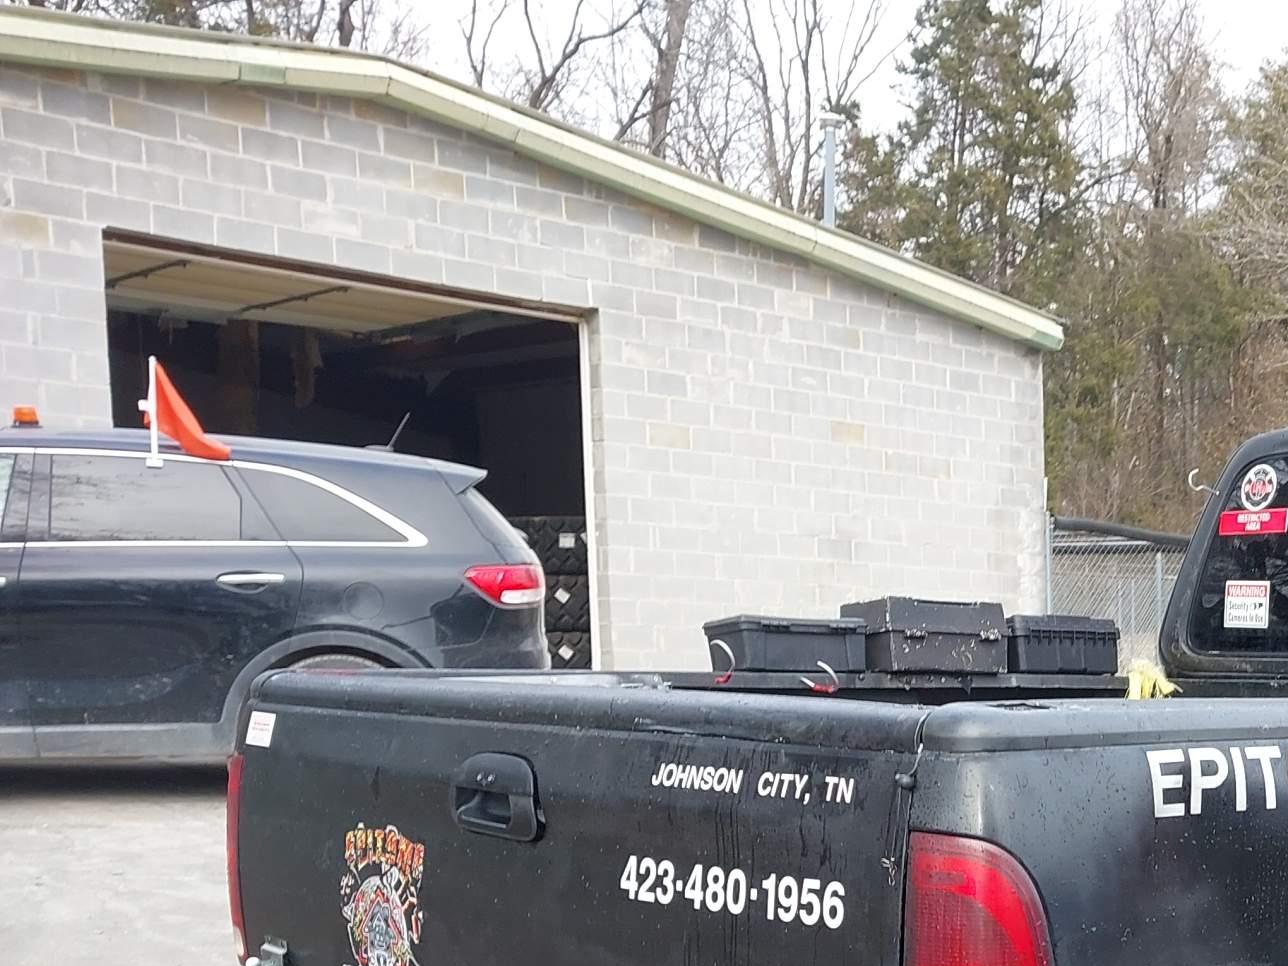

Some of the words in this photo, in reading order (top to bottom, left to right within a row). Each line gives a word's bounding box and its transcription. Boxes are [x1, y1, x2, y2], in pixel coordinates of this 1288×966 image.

[1228, 585, 1267, 598] WARNING
[652, 762, 743, 794] JOHNSON
[757, 771, 811, 805] CITY,
[824, 775, 855, 804] TN
